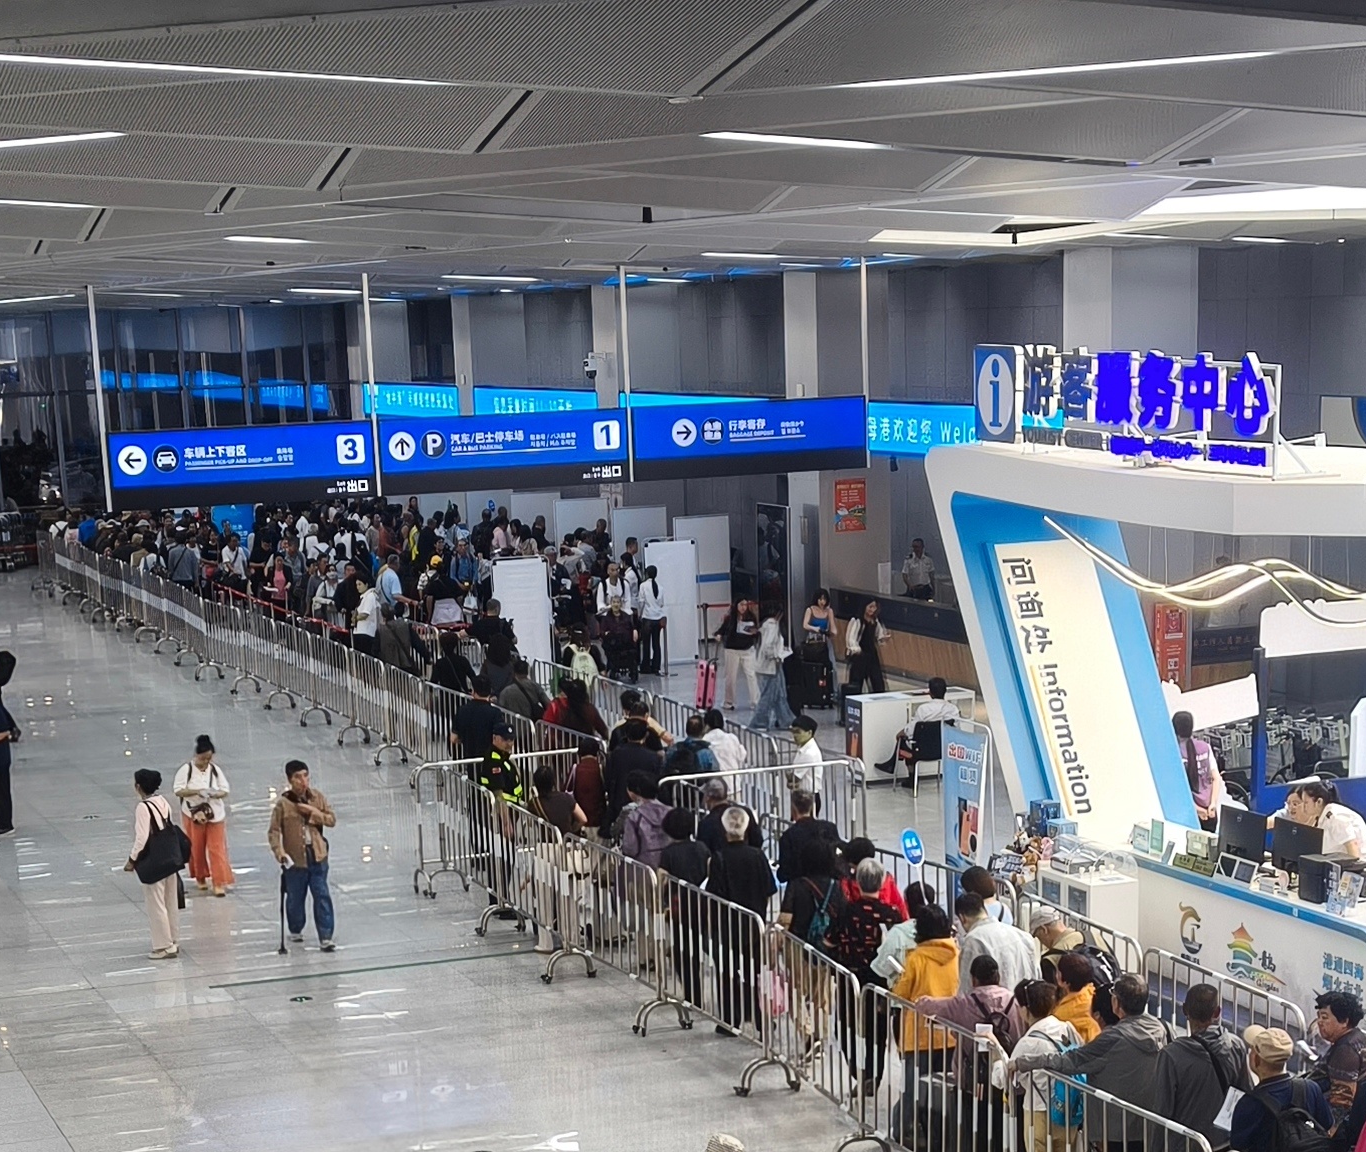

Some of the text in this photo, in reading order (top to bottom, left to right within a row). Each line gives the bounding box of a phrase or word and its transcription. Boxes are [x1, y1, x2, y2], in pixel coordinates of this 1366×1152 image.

[601, 465, 622, 478] 出口
[347, 479, 368, 492] 出口
[1002, 557, 1092, 815] 问询处 Information
